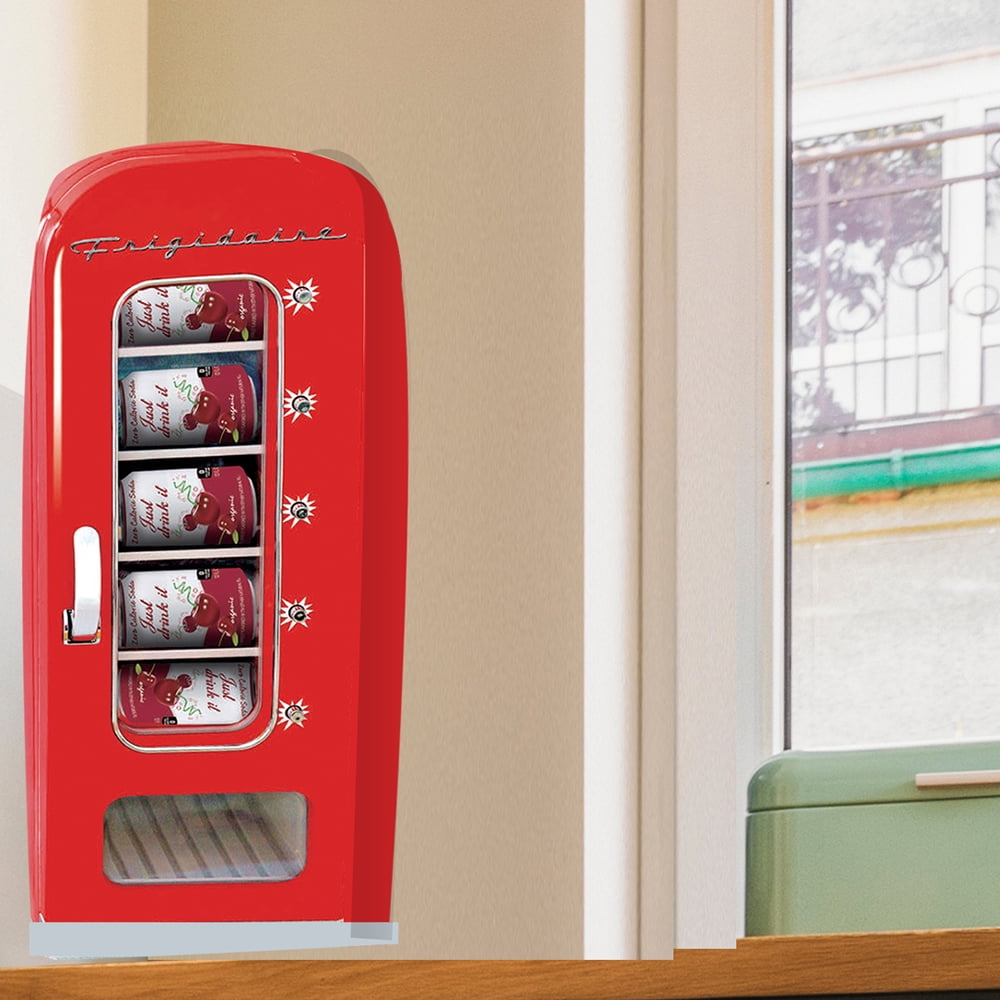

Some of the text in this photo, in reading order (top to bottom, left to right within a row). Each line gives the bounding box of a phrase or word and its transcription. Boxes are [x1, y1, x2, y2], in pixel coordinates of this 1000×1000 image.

[70, 226, 348, 262] Frigidaire
[139, 399, 157, 432] Just
[156, 402, 170, 438] drink
[140, 499, 156, 533] Just
[155, 501, 170, 538] drink
[139, 599, 156, 634] Just
[155, 602, 170, 640] drink
